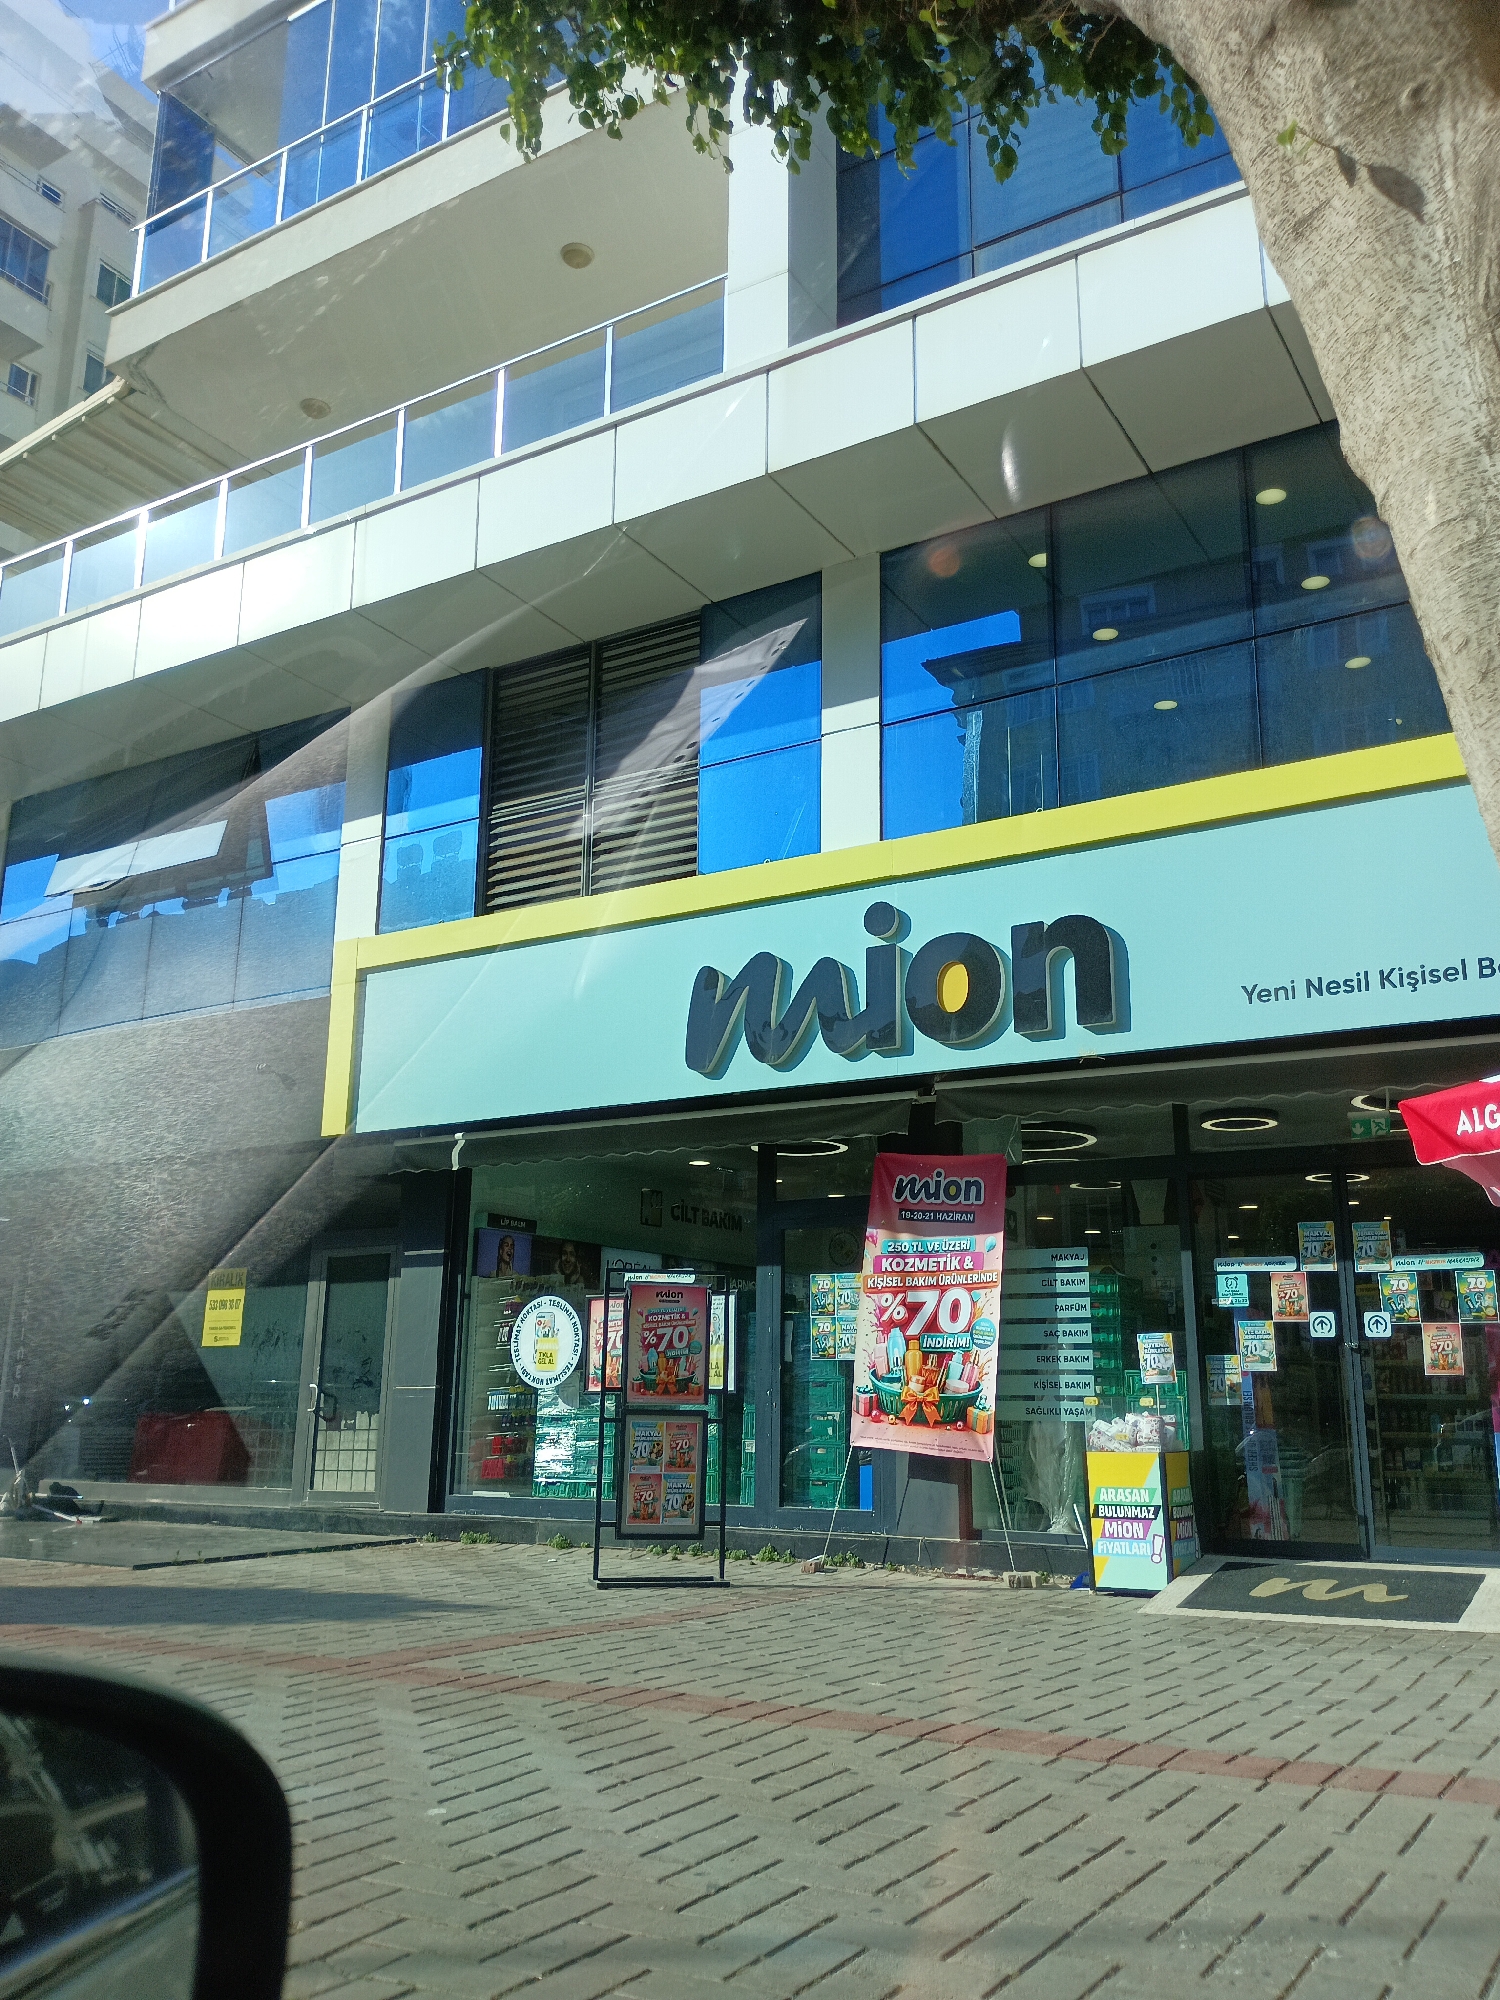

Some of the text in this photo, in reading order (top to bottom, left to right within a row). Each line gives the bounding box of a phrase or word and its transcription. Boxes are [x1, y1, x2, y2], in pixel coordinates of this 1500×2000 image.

[1241, 956, 1500, 1005] Yeni Nesil Kişisel B
[685, 901, 1131, 1079] mion
[893, 1168, 985, 1204] mion
[670, 1199, 743, 1232] CİLT BAKIM
[901, 1211, 974, 1222] 19-20-21 HAZİRAN
[887, 1237, 971, 1252] 250 TL VE ÜZERİ
[881, 1253, 974, 1272] KOZMETİK &
[867, 1269, 998, 1290] KİŞİSEL BAKIM ÜRÜNLERİNDE
[1041, 1277, 1086, 1287] CİLT BAKIM
[656, 1289, 683, 1299] mion
[881, 1287, 973, 1336] %70
[1055, 1303, 1087, 1312] PARFÜM
[648, 1313, 679, 1321] KOZMETİK
[644, 1326, 689, 1352] %70
[1043, 1329, 1089, 1339] SAÇ BAKIM
[513, 1299, 580, 1386] TESLİMAT NOKTASI TESLİMAT NOKTASI TESLİMAT NOKTASI
[1036, 1355, 1090, 1364] ERKEK BAKIM
[1033, 1379, 1091, 1390] KİŞİSEL BAKIM
[1025, 1405, 1093, 1417] SAĞLIKLI YAŞAM
[1100, 1487, 1150, 1503] ARASAN
[1098, 1505, 1156, 1519] BULUNMAZ
